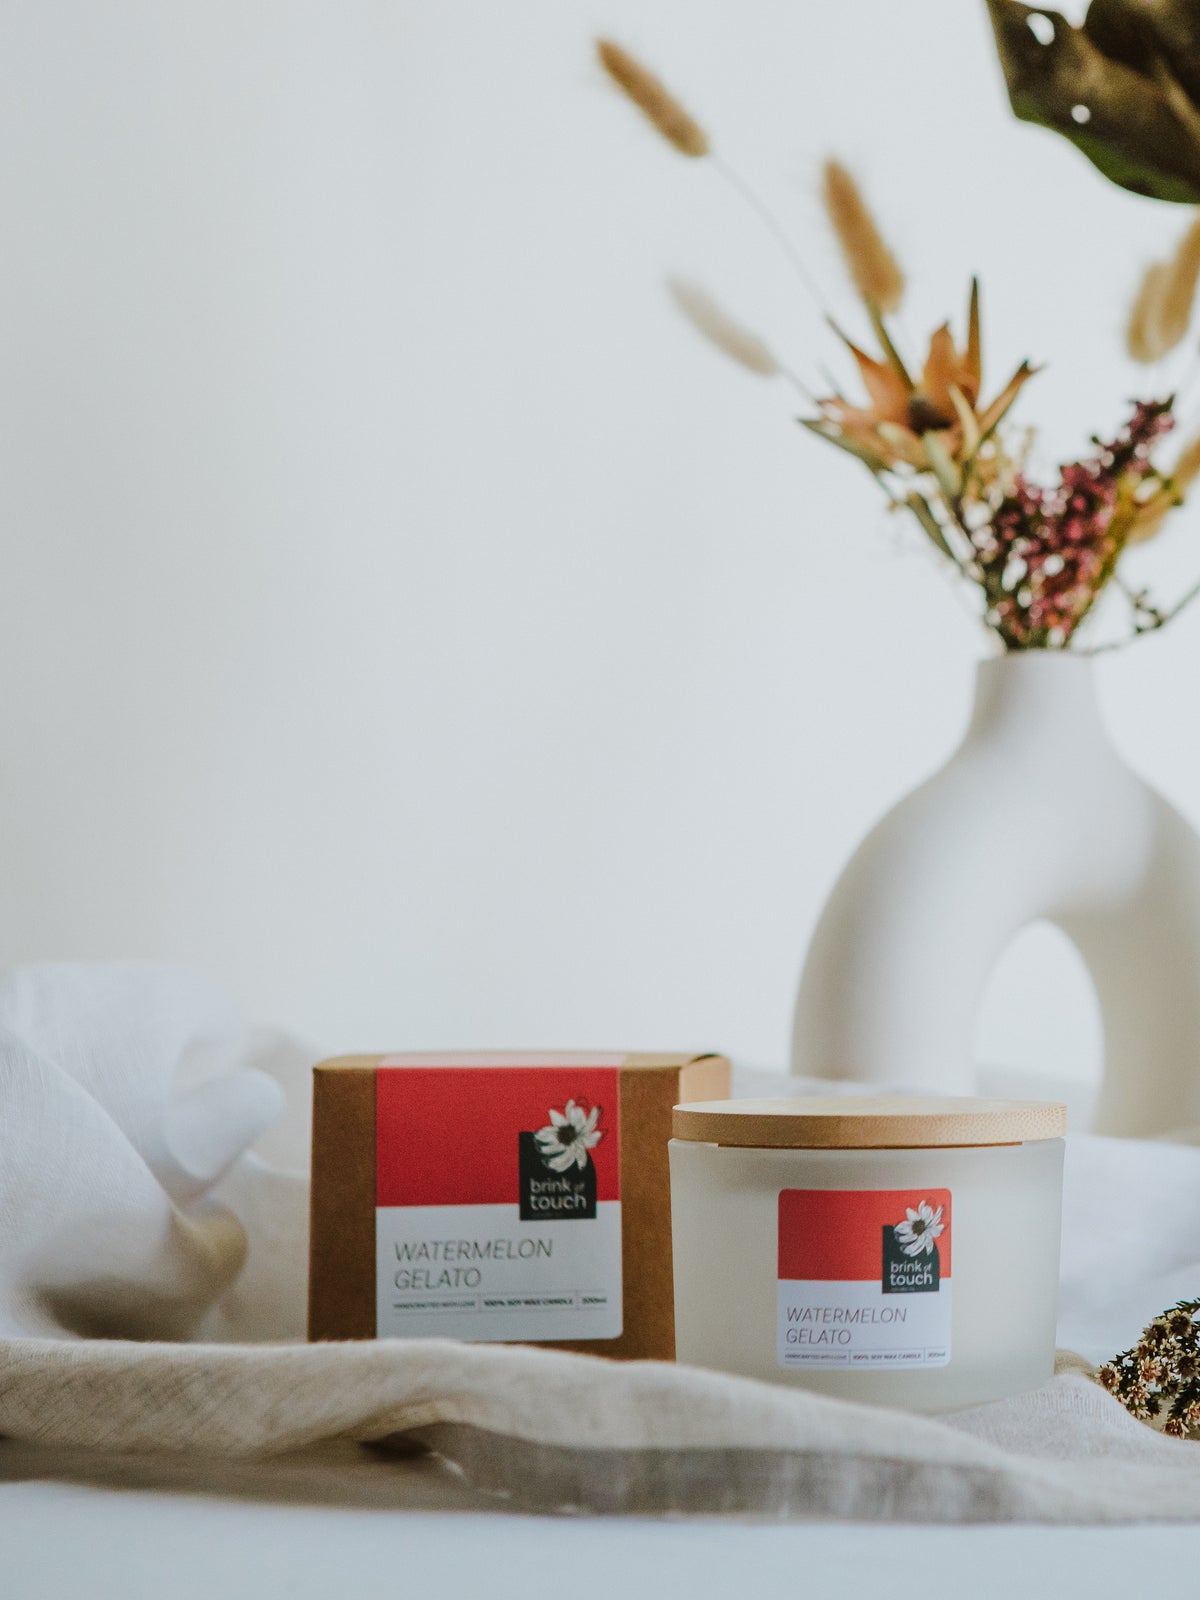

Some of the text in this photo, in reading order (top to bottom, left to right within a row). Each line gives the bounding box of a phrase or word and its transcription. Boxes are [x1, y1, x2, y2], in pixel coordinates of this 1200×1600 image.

[529, 1178, 571, 1194] brink
[529, 1192, 587, 1211] touch
[395, 1239, 553, 1262] WATERMELON
[890, 1260, 921, 1273] brink
[395, 1267, 481, 1290] GELATO
[889, 1271, 933, 1286] touch
[787, 1307, 907, 1324] WATERMELON
[785, 1328, 852, 1345] GELATO
